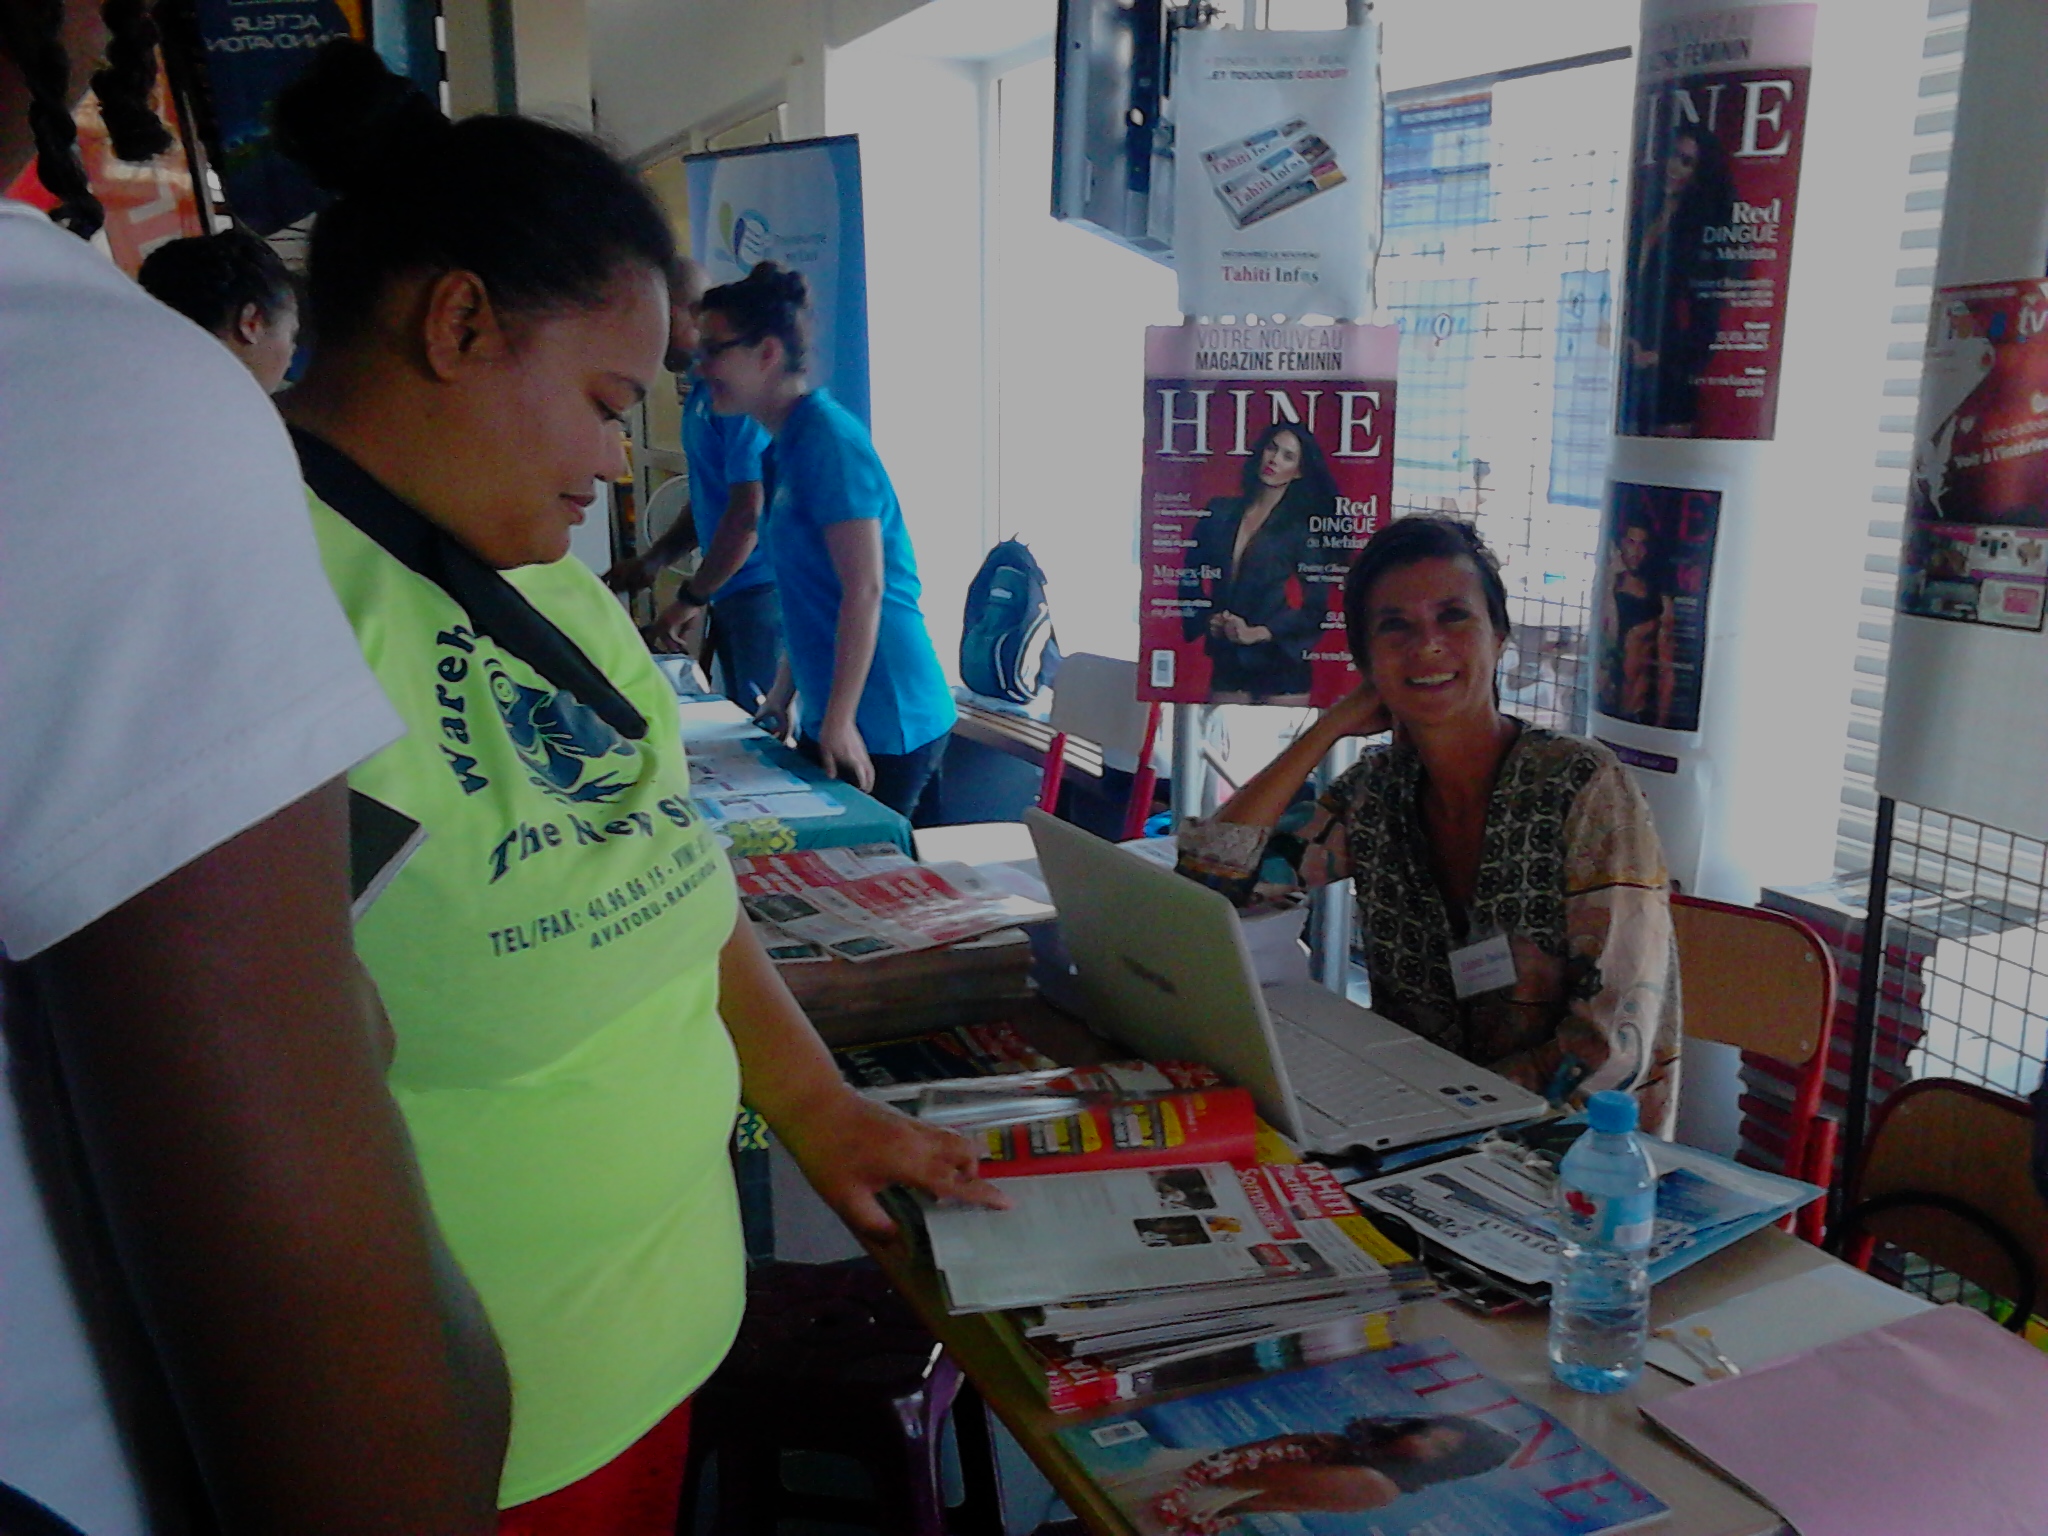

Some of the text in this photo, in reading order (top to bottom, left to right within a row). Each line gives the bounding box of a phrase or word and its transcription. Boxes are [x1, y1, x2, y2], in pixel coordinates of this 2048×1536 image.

[1732, 199, 1780, 224] Red
[1703, 224, 1779, 243] DINGUE
[1221, 265, 1271, 283] Tahiti
[1197, 328, 1345, 352] VOTRE NOUVEAU
[1195, 351, 1274, 371] MAGAZINE
[1155, 388, 1383, 458] HINE
[1334, 495, 1378, 517] Red
[1309, 516, 1378, 534] DINGUE
[488, 820, 562, 885] The
